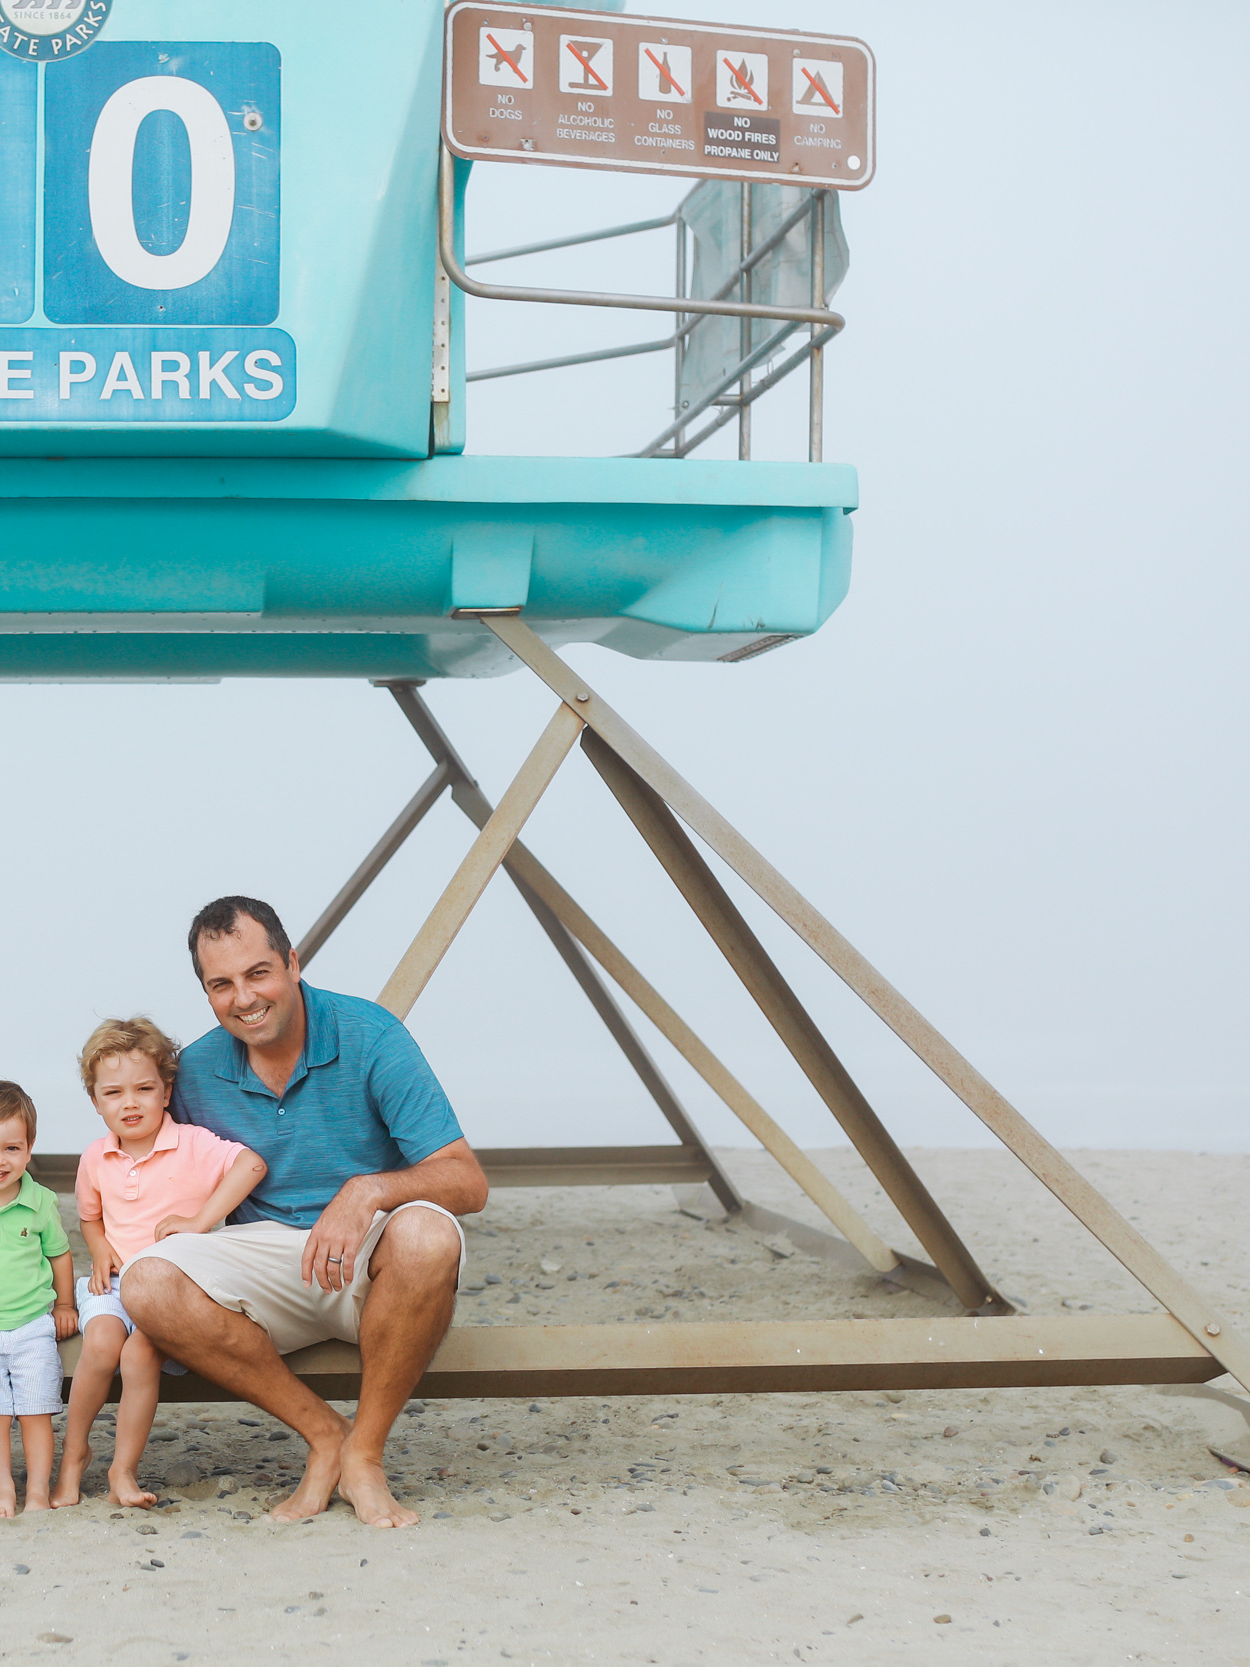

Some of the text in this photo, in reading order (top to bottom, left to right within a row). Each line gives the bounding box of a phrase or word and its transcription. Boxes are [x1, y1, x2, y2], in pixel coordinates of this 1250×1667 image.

[13, 11, 72, 20] SINCE 1864
[50, 0, 107, 56] PARKS
[497, 93, 515, 105] NO
[489, 107, 523, 120] DOGS
[577, 101, 594, 113] NO
[656, 108, 673, 120] NO
[558, 114, 615, 129] ALCOHOLIC
[648, 121, 681, 135] GLASS
[733, 116, 750, 128] NO
[809, 122, 826, 134] NO
[556, 128, 616, 143] BEVERAGES
[707, 127, 777, 145] WOOD FIRES
[793, 135, 842, 150] CAMPING
[634, 135, 696, 151] CONTAINERS
[704, 144, 780, 162] PROPANE ONLY
[58, 348, 285, 401] PARKS
